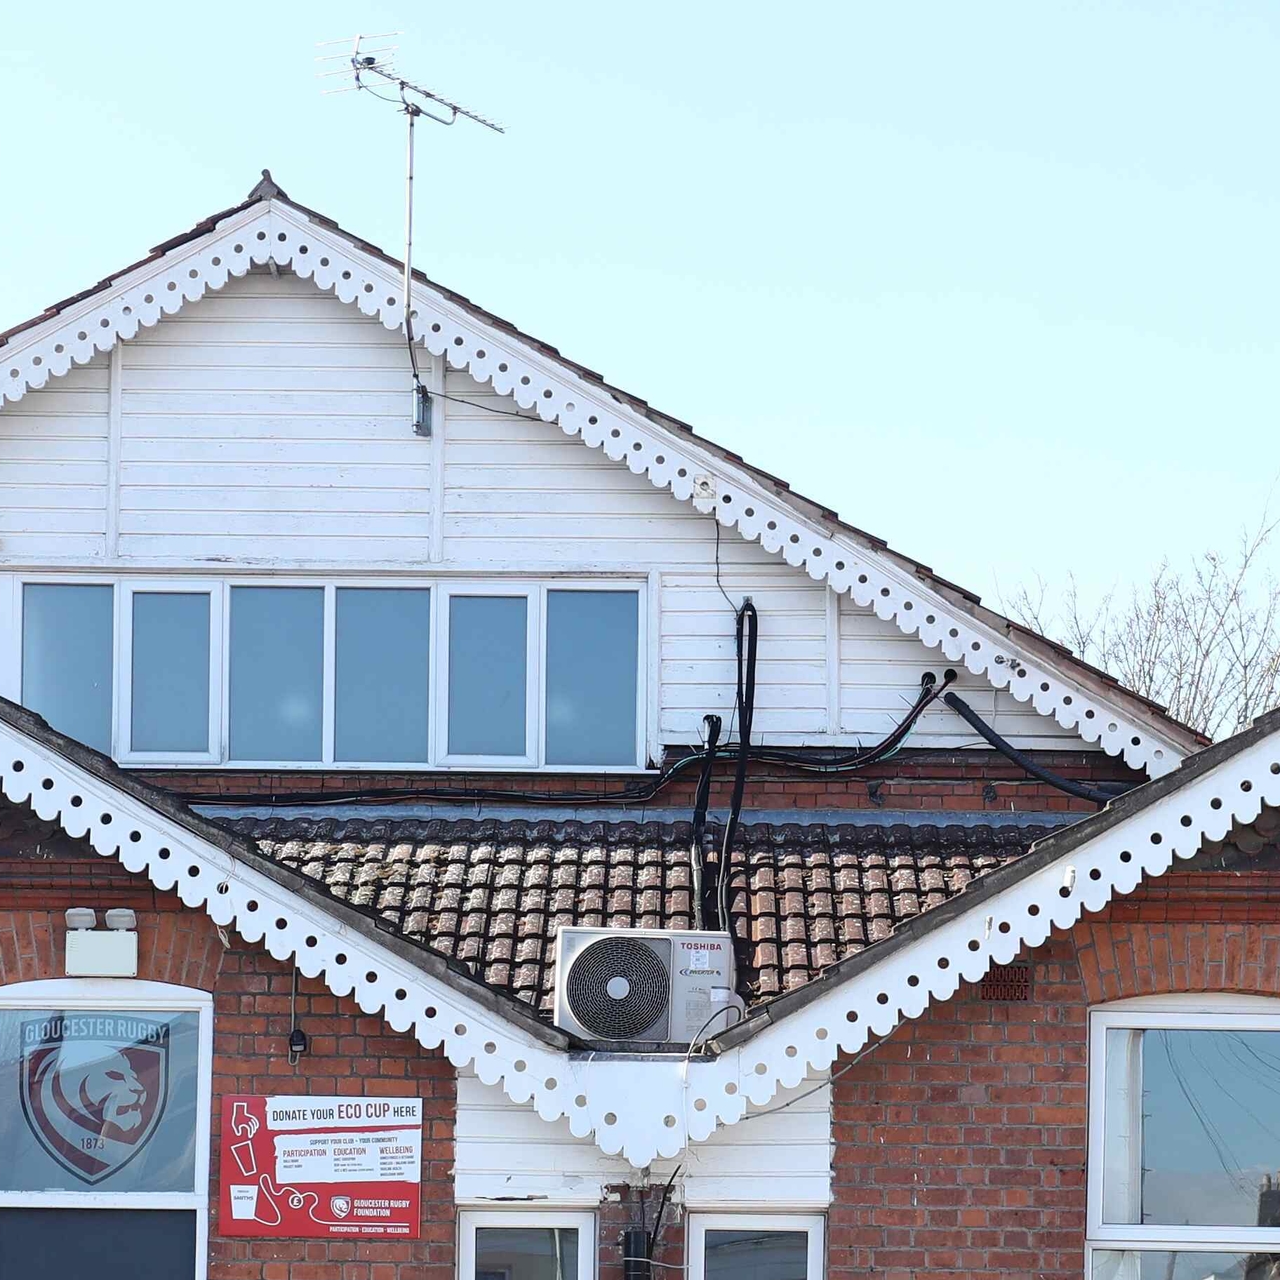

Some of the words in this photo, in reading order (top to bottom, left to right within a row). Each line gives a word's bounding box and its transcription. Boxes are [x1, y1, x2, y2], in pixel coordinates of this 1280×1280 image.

[681, 942, 722, 950] TOSHIBA
[25, 1018, 113, 1042] GLOUCESTER
[117, 1020, 167, 1044] RUGBY
[272, 1109, 308, 1122] DONATE
[310, 1108, 334, 1120] YOUR
[337, 1103, 362, 1119] ECO
[365, 1102, 390, 1118] CUP
[393, 1106, 417, 1117] HERE
[81, 1137, 105, 1150] 1873
[283, 1149, 327, 1157] PARTICIPATION
[333, 1148, 366, 1156] EDUCATION
[379, 1146, 413, 1154] WELLBEING
[390, 1200, 410, 1208] RUGBY
[354, 1208, 390, 1217] FOUNDATION
